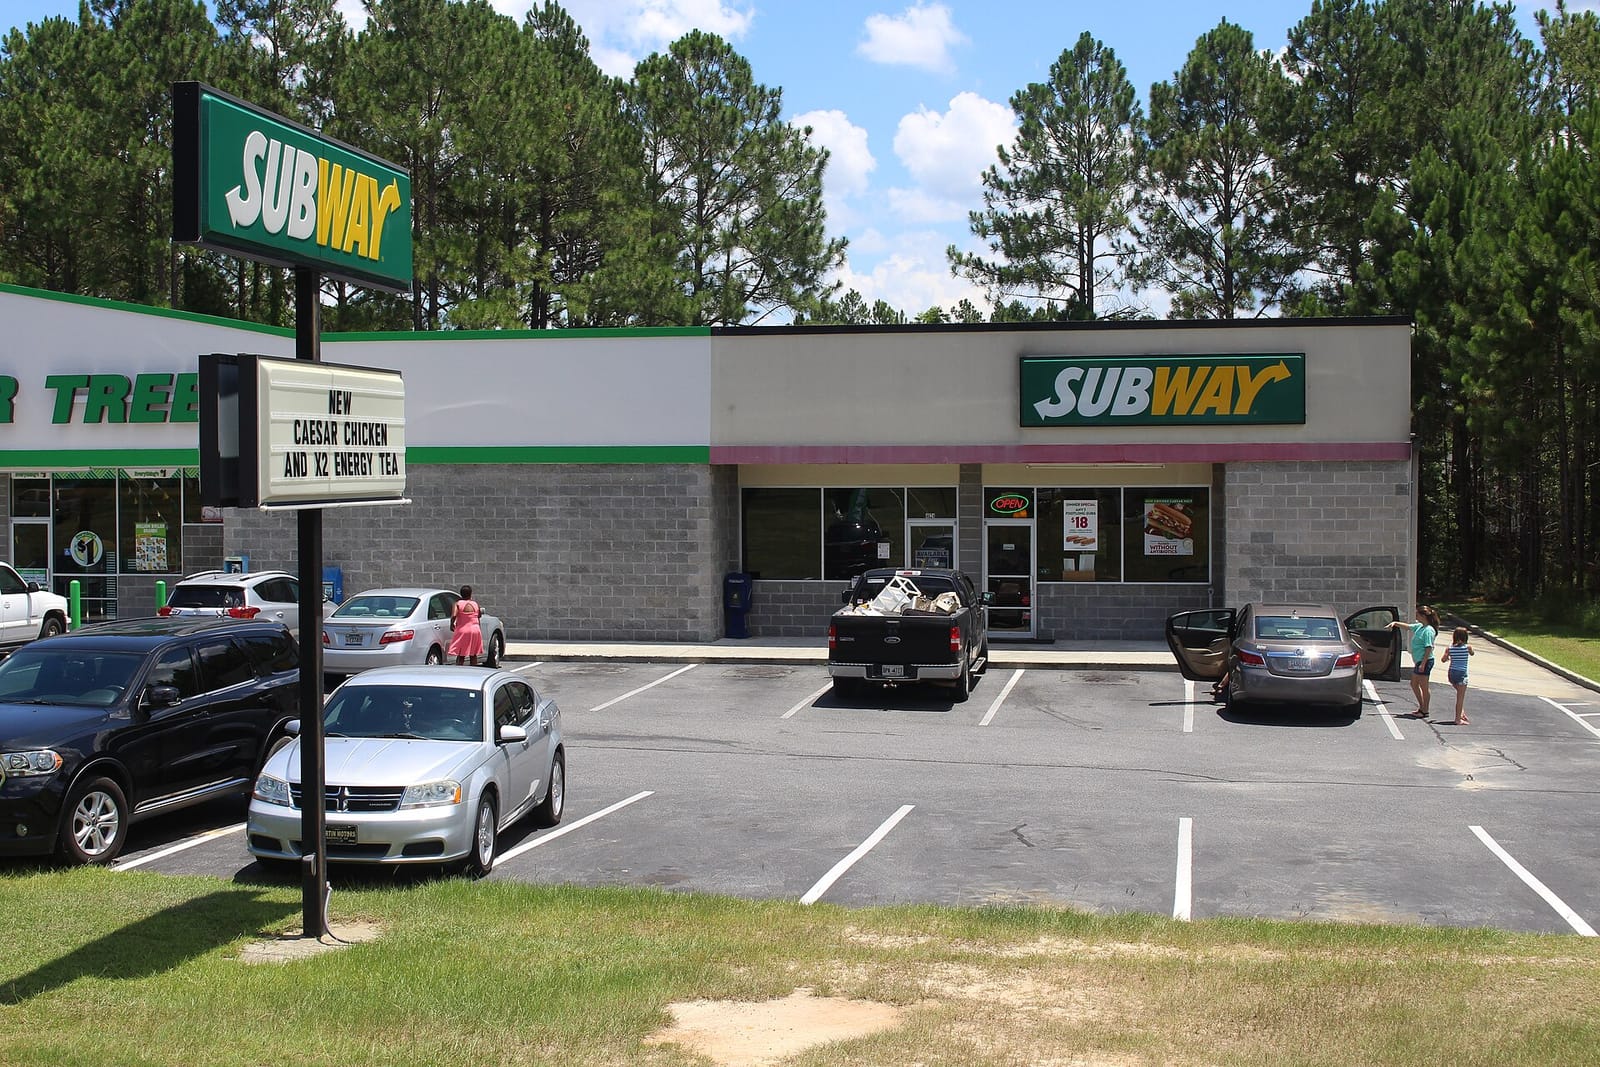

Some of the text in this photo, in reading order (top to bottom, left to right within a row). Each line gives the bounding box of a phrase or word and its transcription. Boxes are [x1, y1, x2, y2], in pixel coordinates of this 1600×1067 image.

[225, 130, 401, 261] SUBWAY
[329, 389, 352, 415] NEW
[1033, 360, 1292, 421] SUBWAY
[294, 419, 388, 446] CAESAR CHICKEN
[284, 452, 399, 477] AND X2 ENERGY TEA
[995, 499, 1024, 509] OPEN
[1071, 516, 1088, 528] $18
